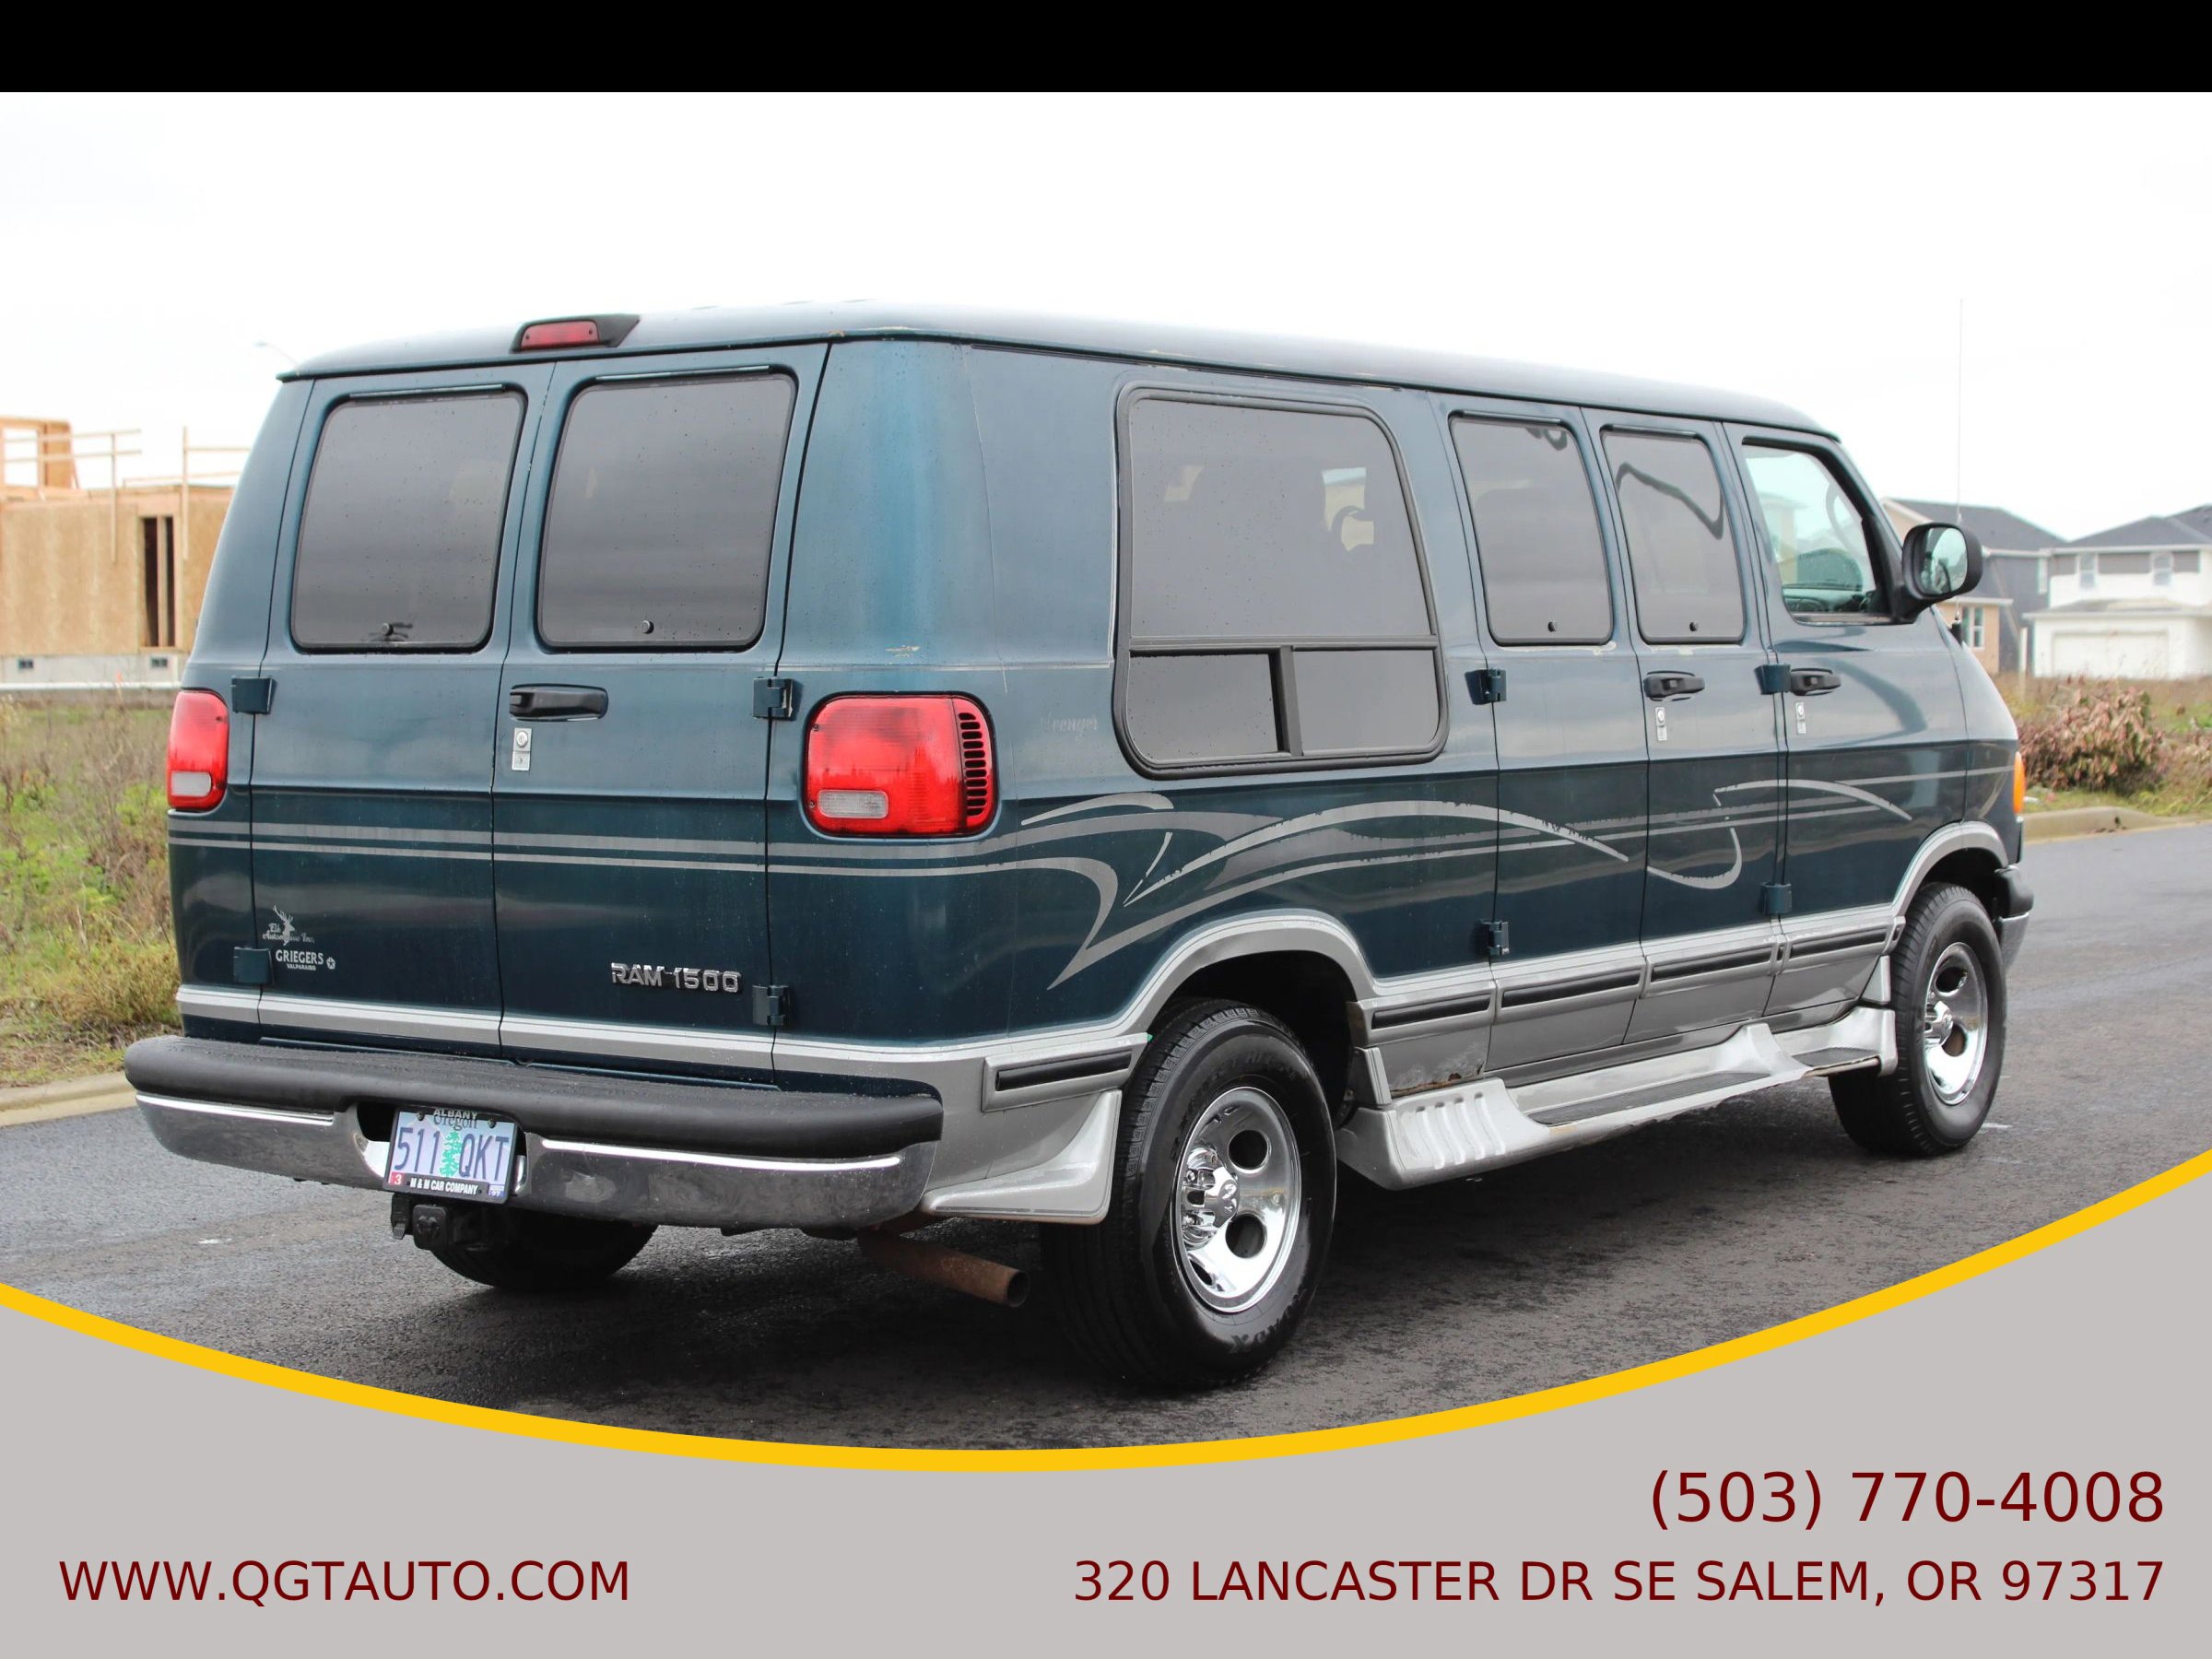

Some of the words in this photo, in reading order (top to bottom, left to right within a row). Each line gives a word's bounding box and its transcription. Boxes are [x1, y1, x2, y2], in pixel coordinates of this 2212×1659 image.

[276, 949, 324, 965] GRIEGERS
[611, 962, 665, 987] RAM
[673, 968, 742, 994] 1500
[433, 1109, 478, 1120] ALBANY
[394, 1126, 441, 1174] 511
[459, 1133, 510, 1182] QKT
[394, 1173, 403, 1185] 3
[409, 1178, 418, 1188] M
[417, 1179, 424, 1189] &
[423, 1180, 430, 1190] M
[430, 1181, 444, 1191] CAR
[445, 1182, 477, 1194] COMPANY
